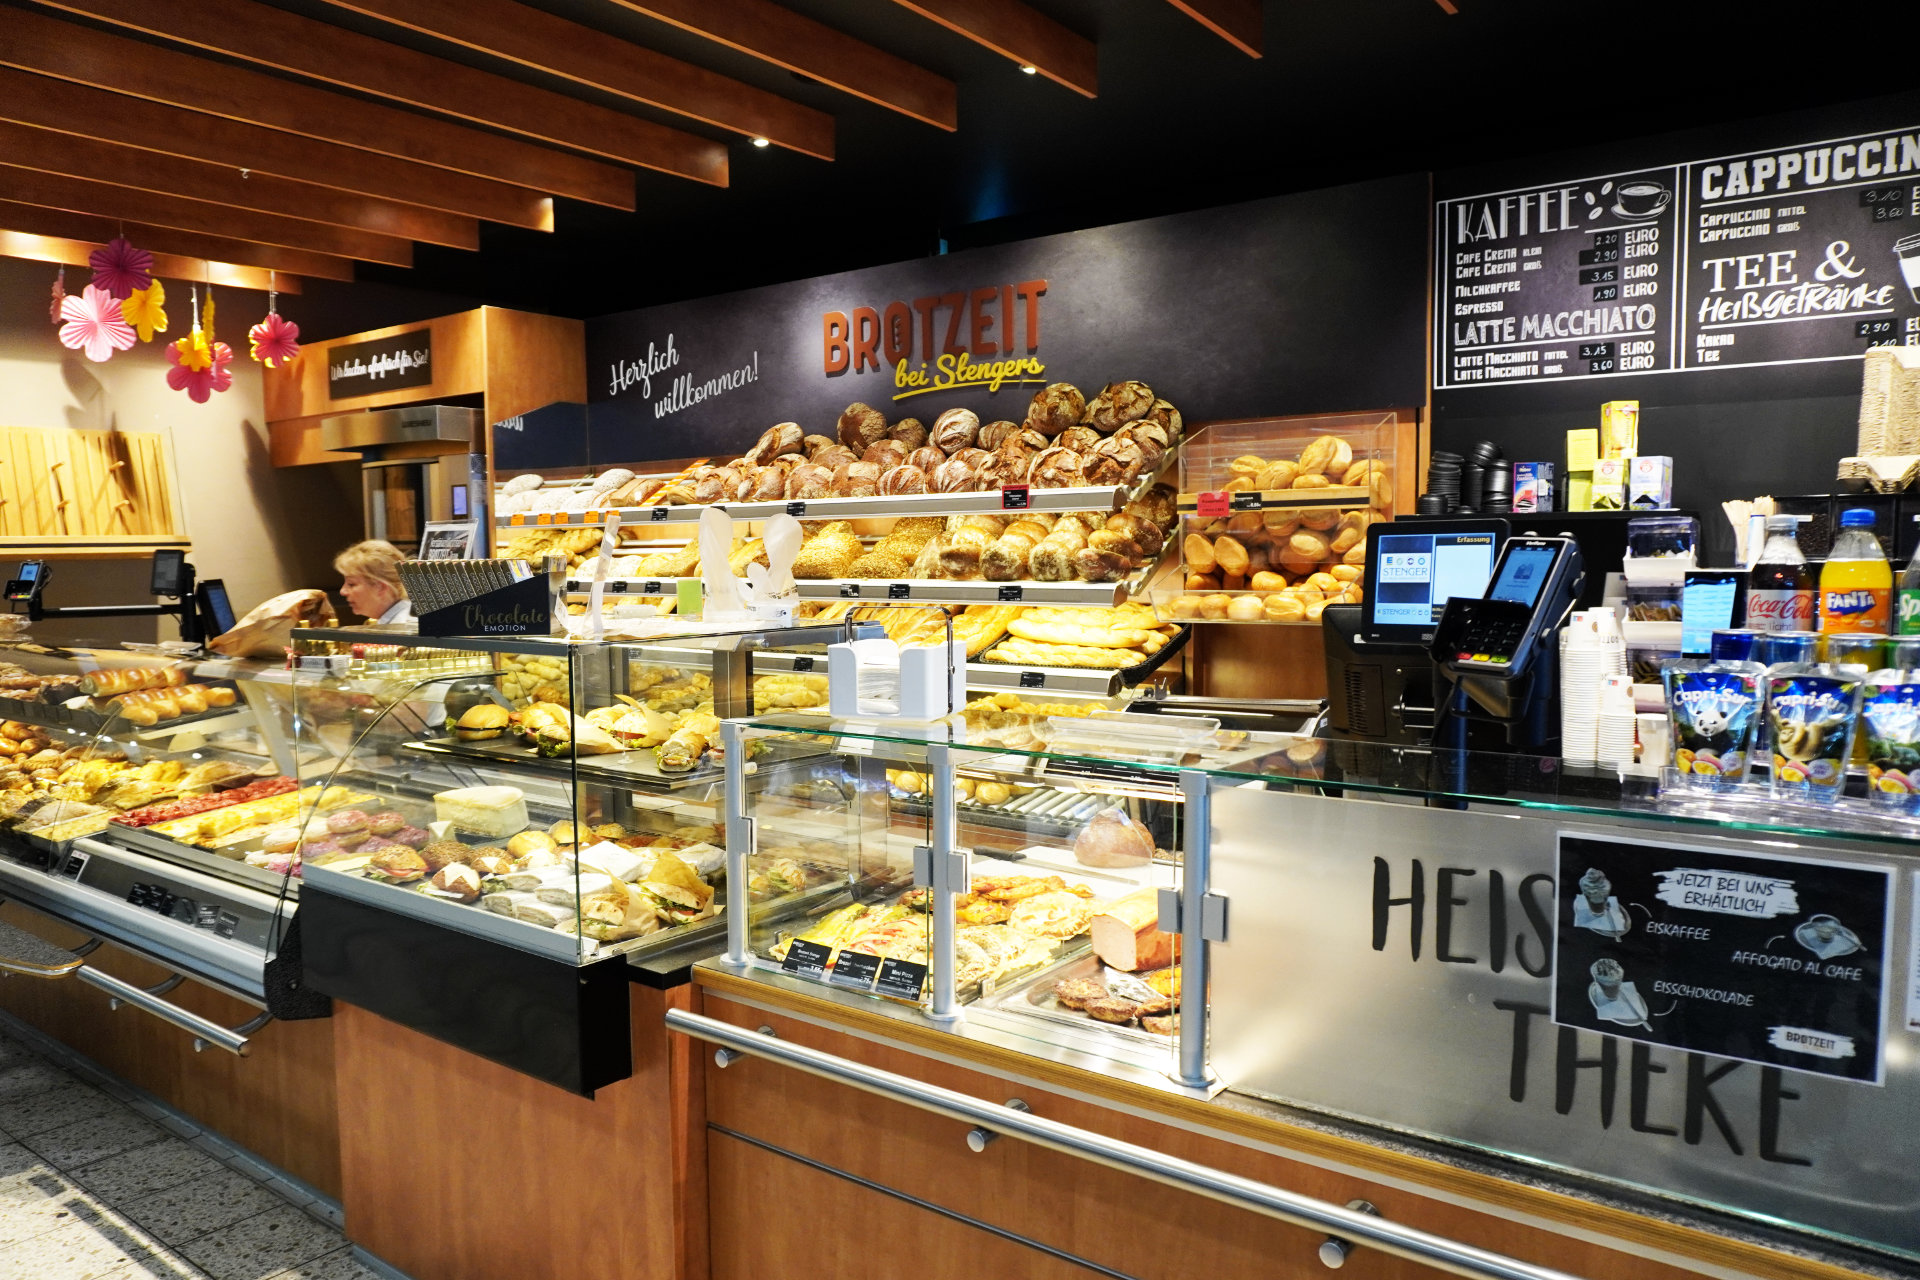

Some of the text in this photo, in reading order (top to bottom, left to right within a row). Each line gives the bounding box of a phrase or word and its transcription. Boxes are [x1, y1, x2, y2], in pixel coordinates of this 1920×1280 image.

[1457, 187, 1579, 244] KAFFEE
[1625, 228, 1659, 244] EURO
[1625, 242, 1658, 258] EURO
[1624, 263, 1658, 279] EURO
[1703, 240, 1865, 292] TEE &
[1455, 301, 1503, 315] ESPRESSO
[1623, 282, 1658, 297] EURO
[823, 279, 1048, 373] BROTZEIT
[1455, 304, 1656, 346] LATTE MACCHIATO
[609, 333, 680, 399] Herzlich
[1455, 355, 1483, 367] LATTE
[1620, 341, 1654, 356] EURO
[1697, 350, 1720, 362] TEE
[895, 352, 1045, 392] bei Stengers
[1455, 369, 1483, 381] LATTE
[1620, 355, 1654, 370] EURO
[654, 351, 758, 419] willkommen!
[1383, 568, 1428, 576] STENGER
[1827, 591, 1875, 608] FANTA
[462, 604, 547, 630] Chocolate
[1676, 873, 1774, 895] JETZT BEI UNS
[1685, 892, 1765, 913] ERHÄLTLICH
[1646, 922, 1711, 940] EISKAFFEE
[1732, 951, 1862, 981] AFFOGATO AL CAFE
[1654, 981, 1754, 1006] EISSCHOKOLADE
[1786, 1032, 1835, 1050] BROTZEIT
[1494, 1001, 1812, 1167] THEKE
